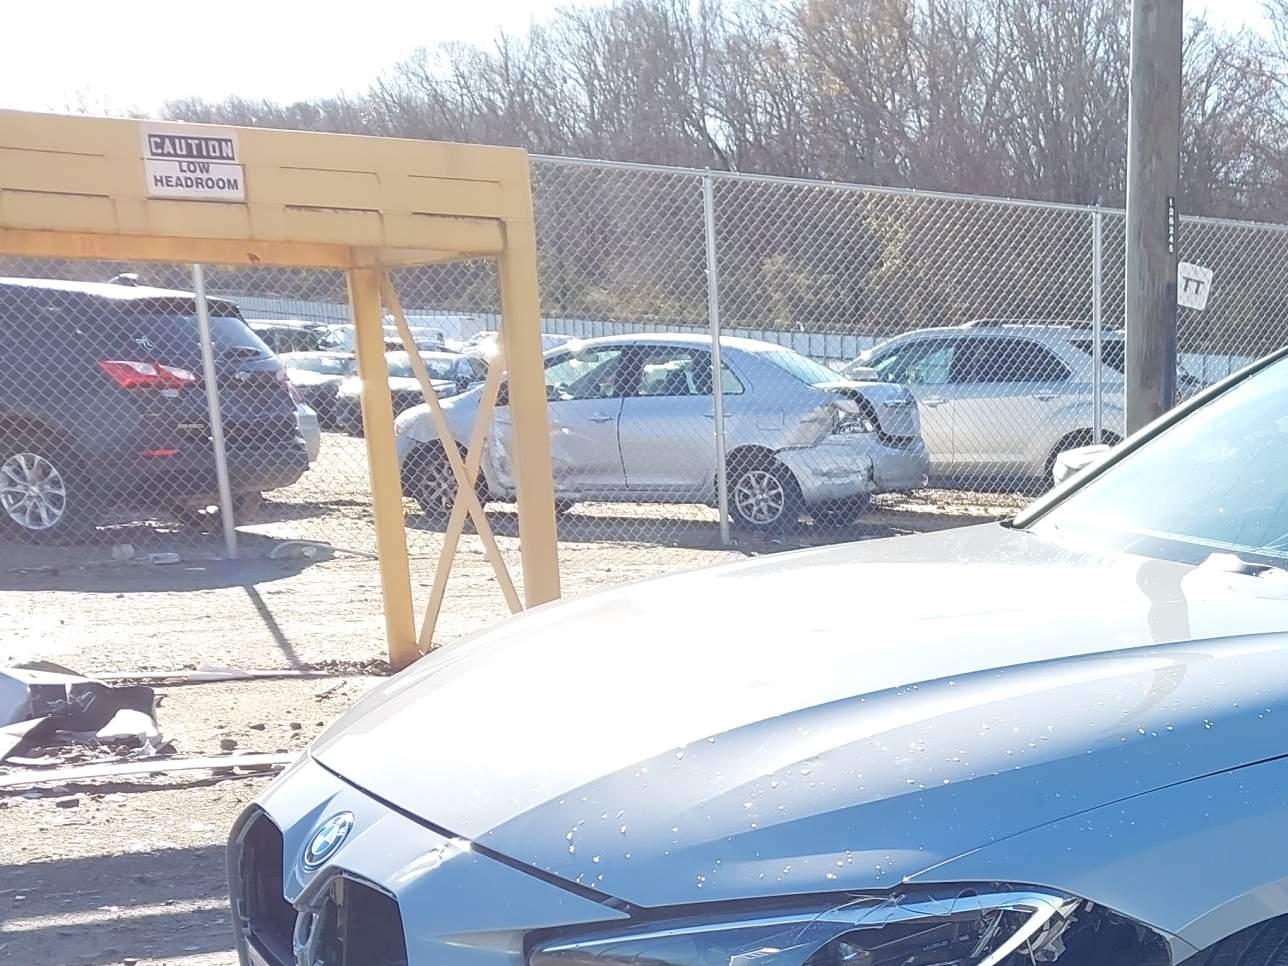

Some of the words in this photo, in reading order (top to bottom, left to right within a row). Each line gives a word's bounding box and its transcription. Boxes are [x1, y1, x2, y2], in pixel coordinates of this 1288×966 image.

[150, 137, 233, 158] CAUTION
[178, 161, 210, 174] LOW
[153, 174, 239, 191] HEADROOM
